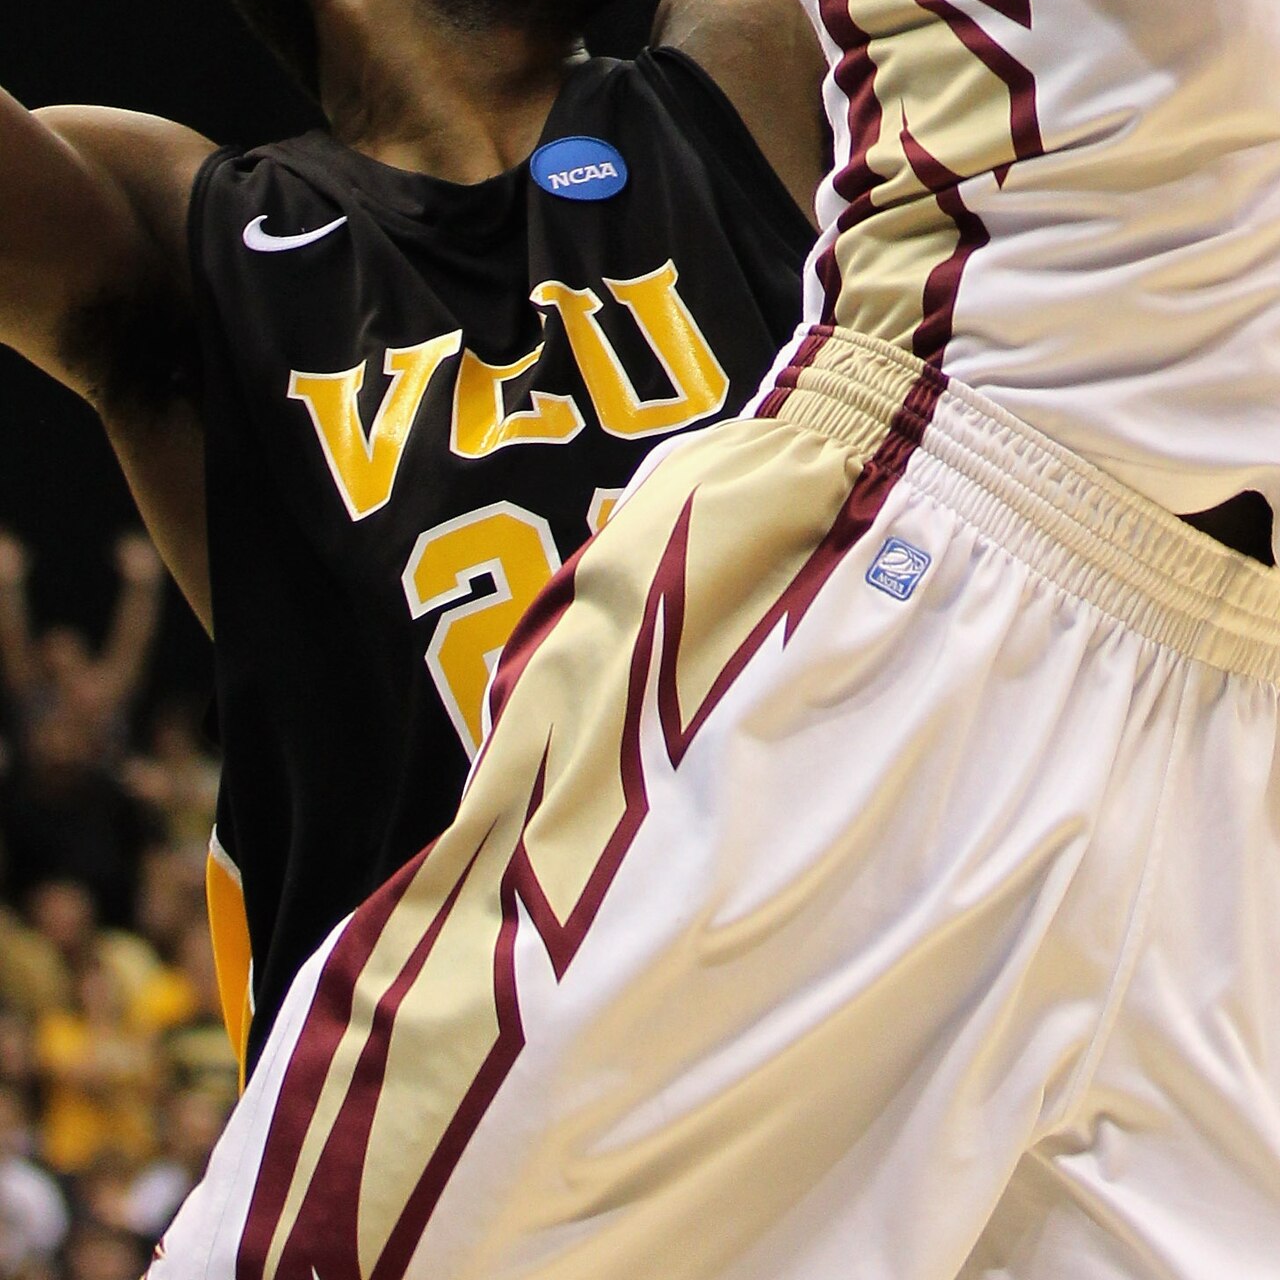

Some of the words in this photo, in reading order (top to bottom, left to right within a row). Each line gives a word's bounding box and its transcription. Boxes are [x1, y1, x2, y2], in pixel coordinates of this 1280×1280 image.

[548, 162, 618, 190] NCAA
[287, 258, 730, 522] VCU
[401, 487, 626, 762] 2
